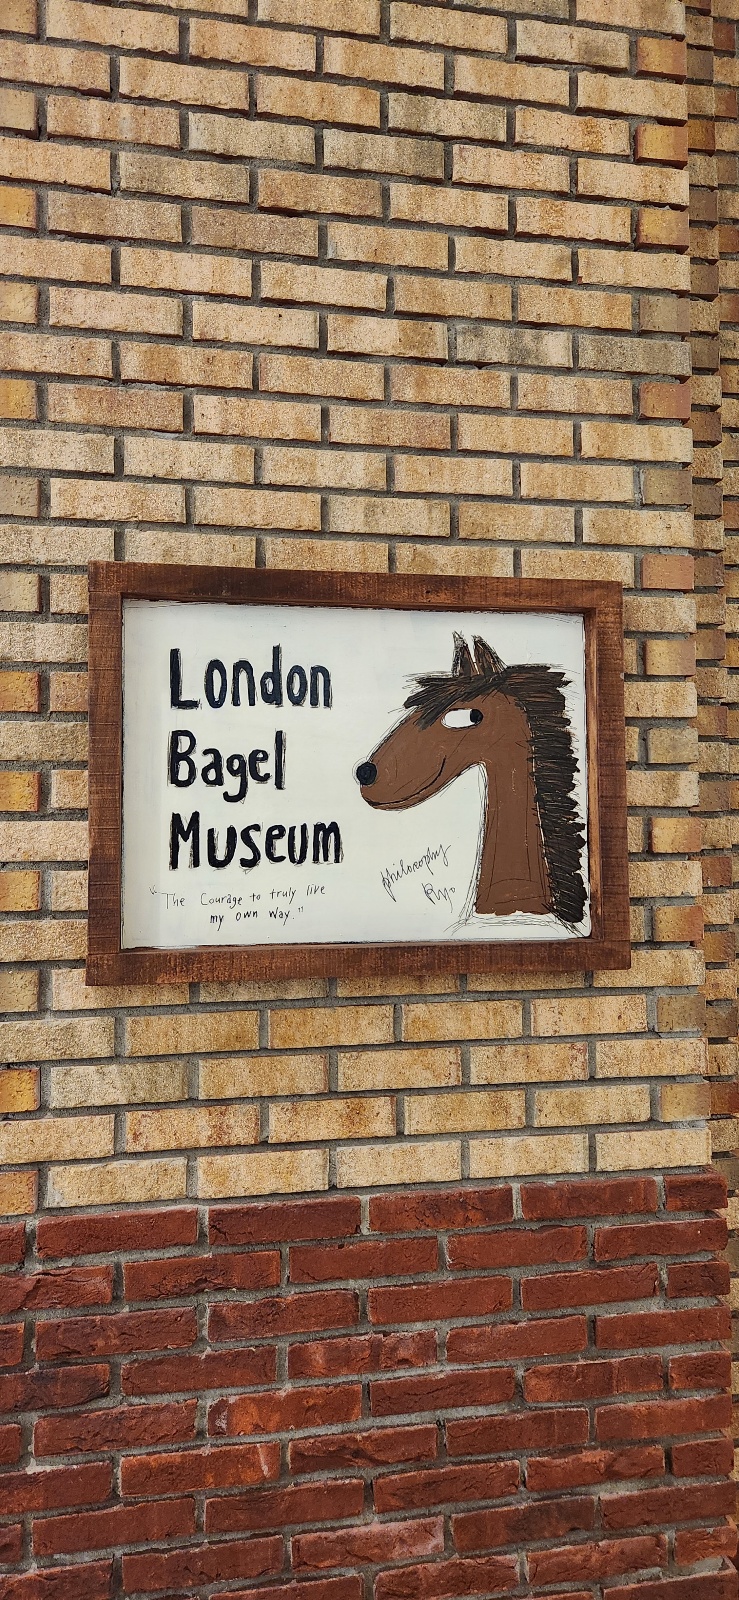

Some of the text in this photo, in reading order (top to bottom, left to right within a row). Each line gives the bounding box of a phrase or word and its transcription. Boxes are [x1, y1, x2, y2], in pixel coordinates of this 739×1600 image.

[169, 643, 333, 710] London
[167, 728, 286, 804] Bagel
[169, 811, 344, 873] Museum
[200, 892, 243, 909] Courage
[249, 894, 261, 902] to
[269, 888, 297, 905] truly
[306, 883, 326, 896] live
[210, 914, 225, 931] my
[235, 910, 258, 921] own
